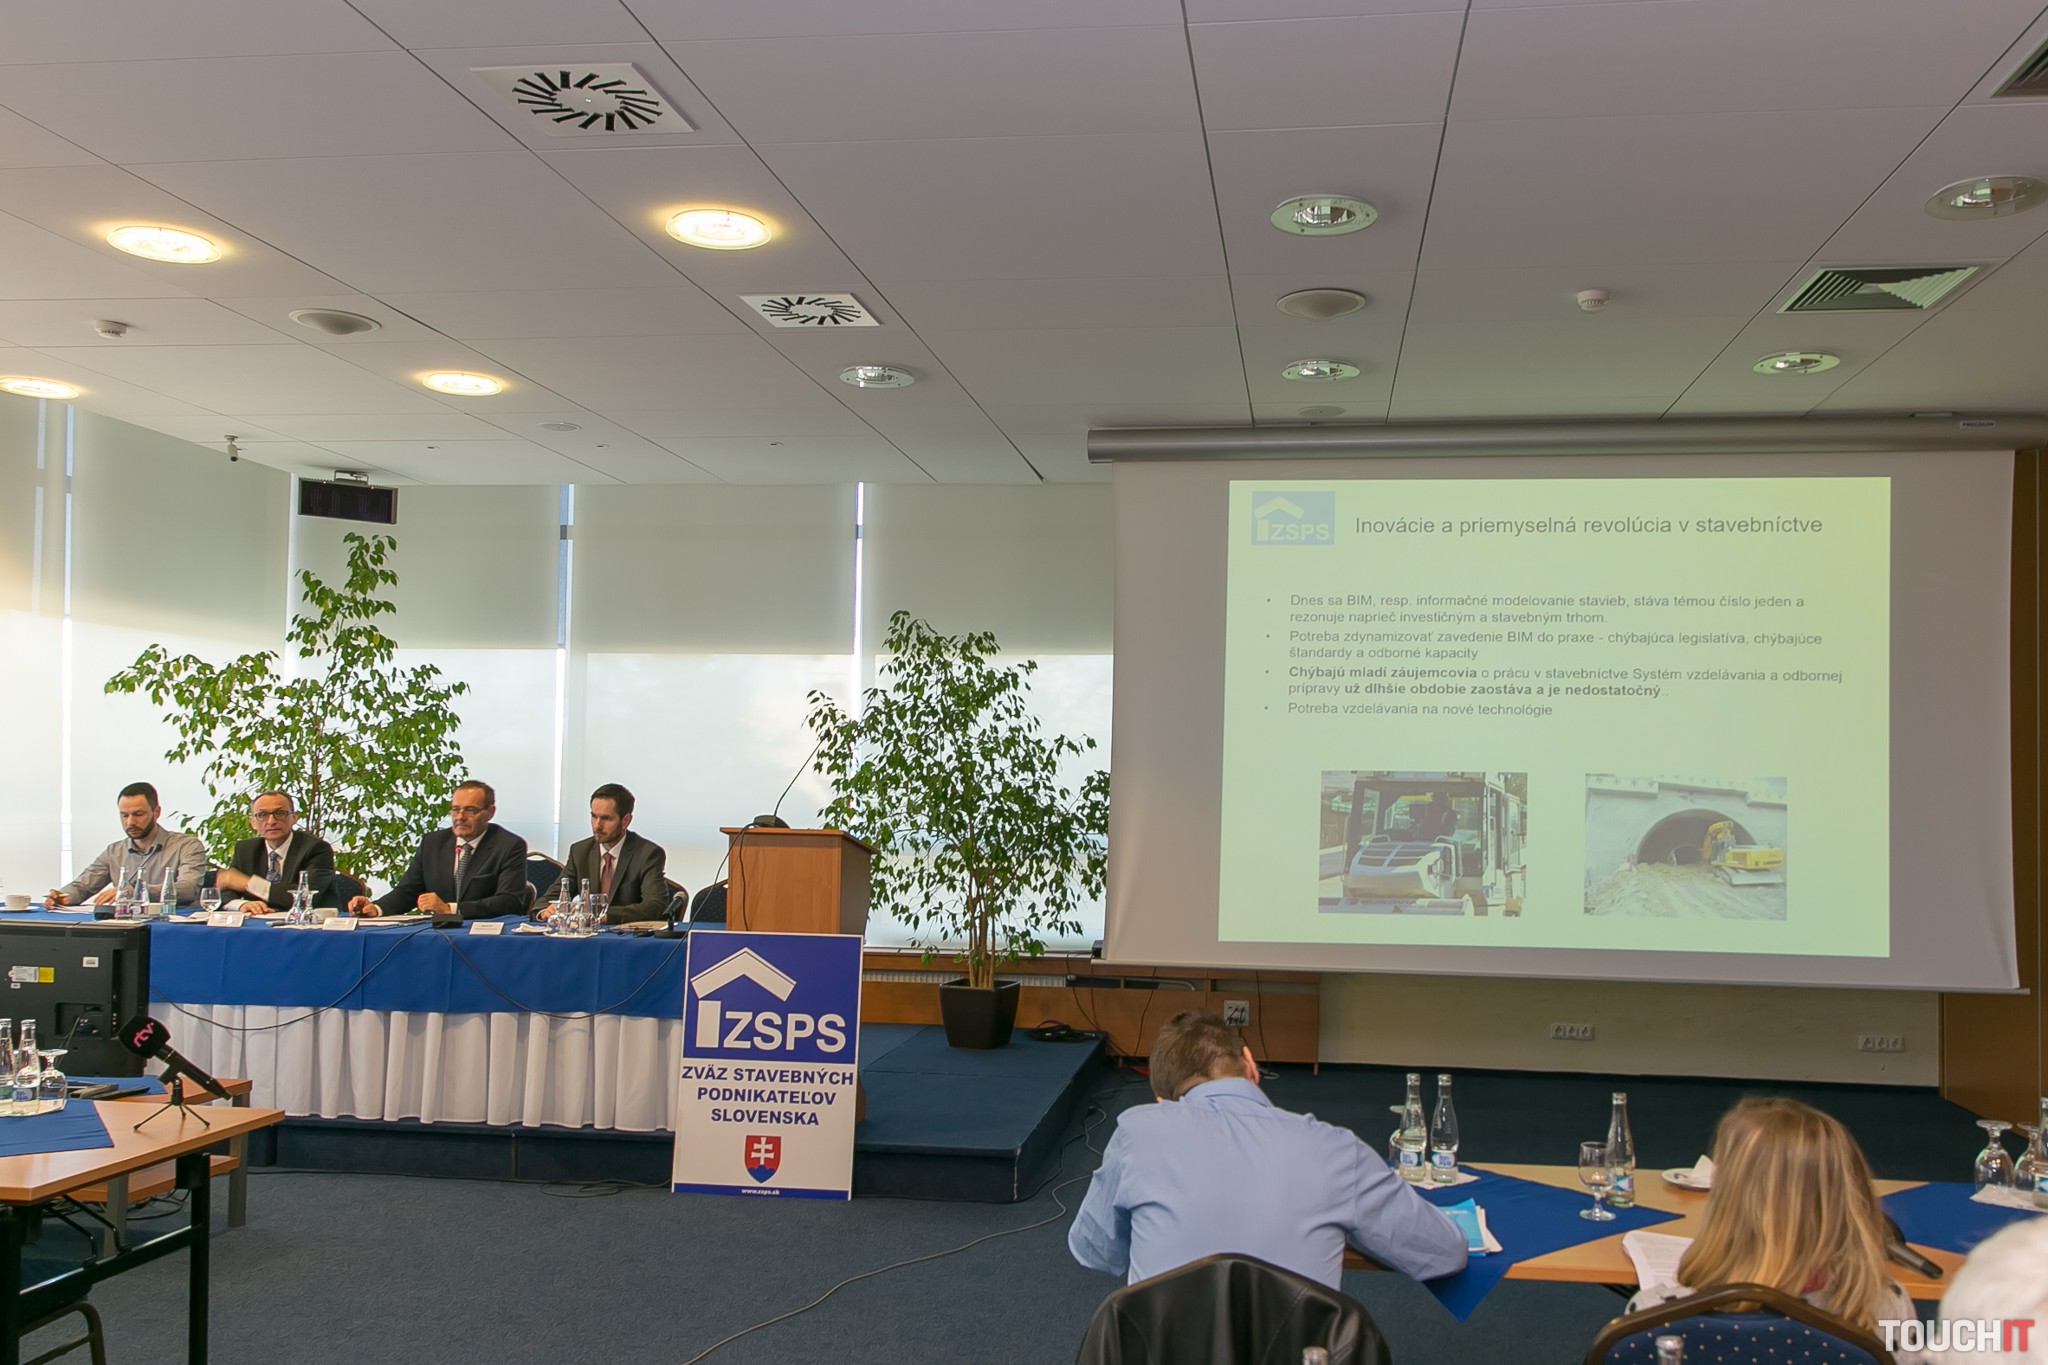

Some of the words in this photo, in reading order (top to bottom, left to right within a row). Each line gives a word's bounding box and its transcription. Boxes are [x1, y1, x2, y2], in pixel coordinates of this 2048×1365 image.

[1271, 523, 1330, 541] ZSPS
[1356, 517, 1435, 533] Inovácie
[1442, 521, 1452, 533] a
[1460, 516, 1576, 537] priemyselná
[1584, 516, 1671, 533] revolúcia
[1679, 520, 1689, 532] v
[1696, 516, 1822, 532] stavebníctve
[1291, 595, 1323, 605] Dnes
[1328, 597, 1342, 605] sa
[1347, 595, 1375, 607] BIM,
[1381, 597, 1411, 608] resp.
[1417, 595, 1488, 606] informačné
[1493, 595, 1575, 606] modelovanie
[1579, 595, 1629, 608] stavieb,
[1634, 595, 1669, 606] stáva
[1674, 595, 1715, 606] témou
[1720, 596, 1750, 606] číslo
[1754, 596, 1791, 609] jeden
[1796, 599, 1804, 607] a
[1290, 611, 1344, 624] rezonuje
[1349, 611, 1396, 624] naprieč
[1400, 611, 1475, 625] investičným
[1480, 614, 1487, 622] a
[1492, 612, 1562, 625] stavebným
[1290, 631, 1339, 641] Potreba
[1344, 631, 1433, 644] zdynamizovať
[1437, 632, 1503, 642] zavedenie
[1508, 631, 1533, 642] BIM
[1537, 632, 1553, 642] do
[1558, 634, 1594, 645] praxe
[1608, 632, 1674, 645] chýbajúca
[1754, 633, 1822, 647] chýbajúce
[1290, 647, 1352, 660] štandardy
[1368, 648, 1420, 658] odborné
[1425, 648, 1478, 661] kapacity
[1289, 666, 1345, 680] Chýbajú
[1350, 666, 1387, 677] mladí
[1391, 667, 1477, 680] záujemcovia
[1481, 670, 1489, 678] o
[1494, 667, 1529, 680] prácu
[1534, 670, 1541, 678] v
[1546, 668, 1628, 679] stavebníctve
[1633, 668, 1681, 682] Systém
[1687, 669, 1765, 680] vzdelávania
[1770, 672, 1778, 680] a
[1783, 670, 1842, 684] odbornej
[1289, 683, 1340, 696] prípravy
[1345, 683, 1360, 693] už
[1365, 683, 1406, 694] dlhšie
[1410, 683, 1466, 694] obdobie
[1471, 683, 1531, 694] zaostáva
[1536, 687, 1544, 695] a
[1548, 684, 1560, 697] je
[1288, 702, 1338, 713] Potreba
[1342, 703, 1418, 714] vzdelávania
[1423, 706, 1438, 714] na
[1443, 704, 1474, 714] nové
[1479, 704, 1552, 718] technológie
[723, 1010, 847, 1053] ZSPS
[681, 1065, 727, 1080] ZVÄZ
[733, 1067, 854, 1086] STAVEBNÝCH
[697, 1087, 836, 1105] PODNIKATEĽOV
[711, 1108, 819, 1125] SLOVENSKA
